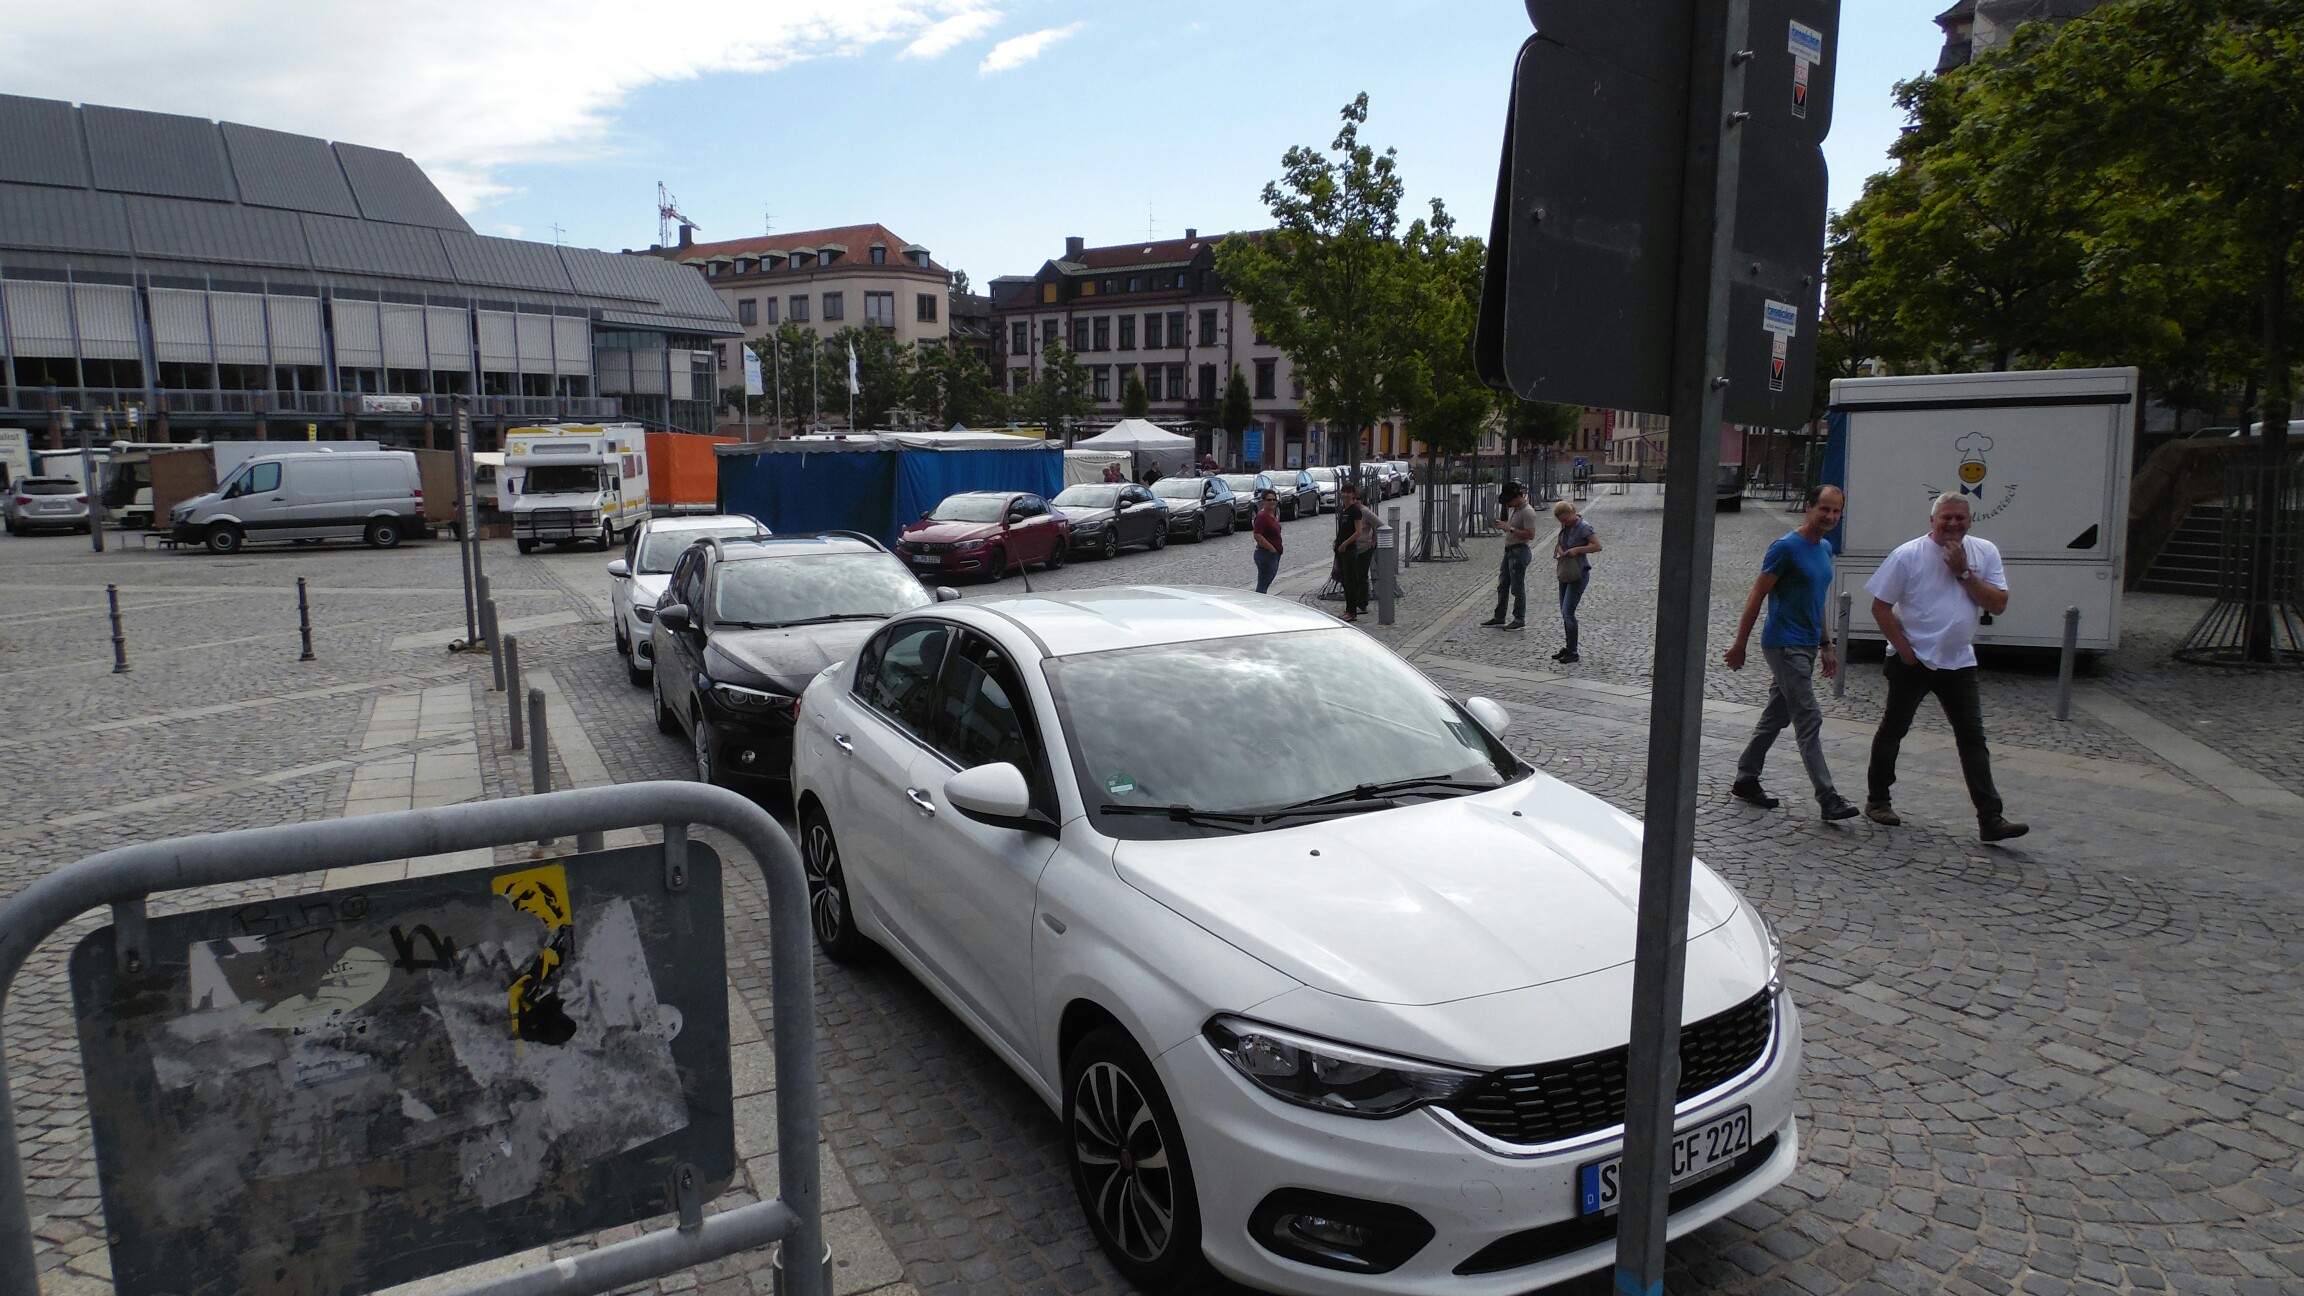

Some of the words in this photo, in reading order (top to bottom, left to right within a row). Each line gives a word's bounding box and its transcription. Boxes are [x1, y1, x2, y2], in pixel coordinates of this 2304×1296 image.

[1971, 484, 2019, 523] linarisch
[1601, 1164, 1620, 1203] S
[1671, 1132, 1702, 1177] CF
[1706, 1115, 1747, 1163] 222
